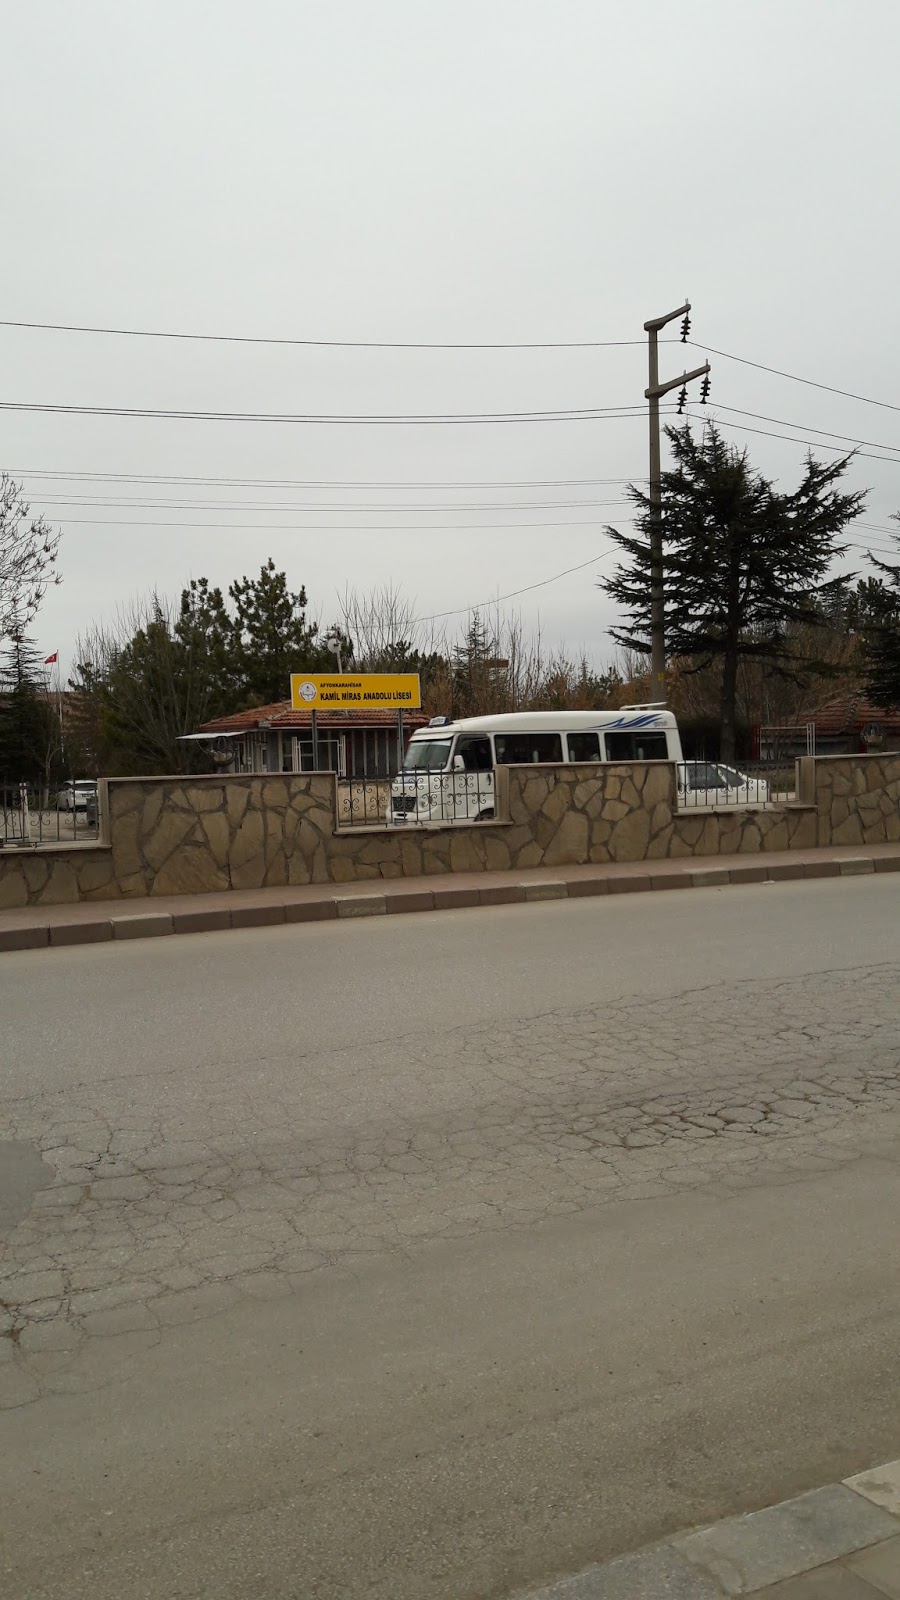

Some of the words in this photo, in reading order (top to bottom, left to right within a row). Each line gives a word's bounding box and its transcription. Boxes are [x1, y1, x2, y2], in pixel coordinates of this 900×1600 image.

[320, 691, 340, 701] KAMİL
[342, 691, 361, 700] MİRAS
[363, 692, 392, 700] ANADOLU
[392, 690, 412, 700] LİSESİ
